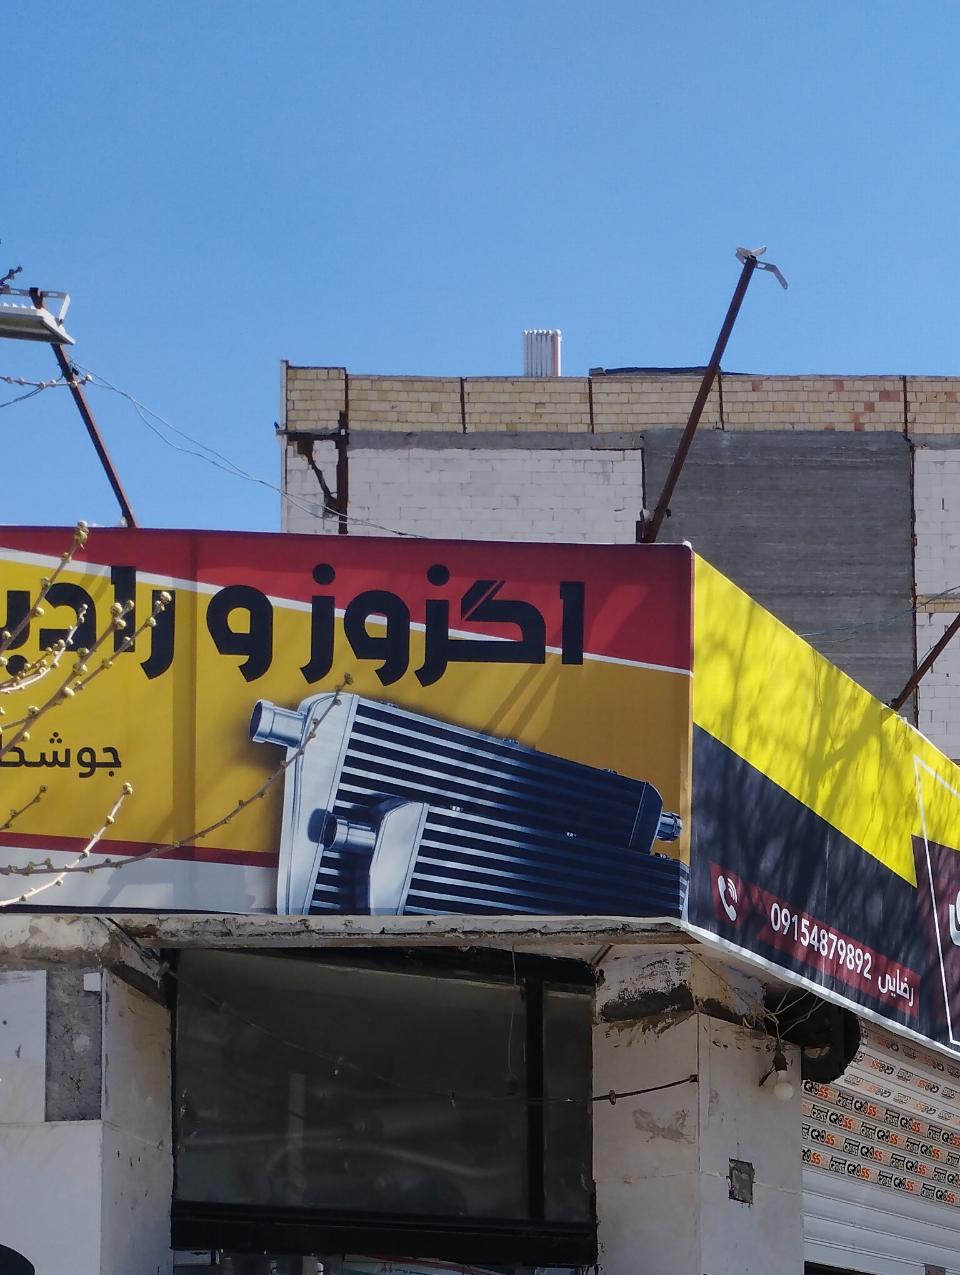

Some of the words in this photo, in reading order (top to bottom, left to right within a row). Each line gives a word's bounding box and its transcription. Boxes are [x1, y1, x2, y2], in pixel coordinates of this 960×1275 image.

[205, 584, 274, 683] و
[770, 902, 872, 981] 09154879892
[877, 968, 914, 1007] رضایی
